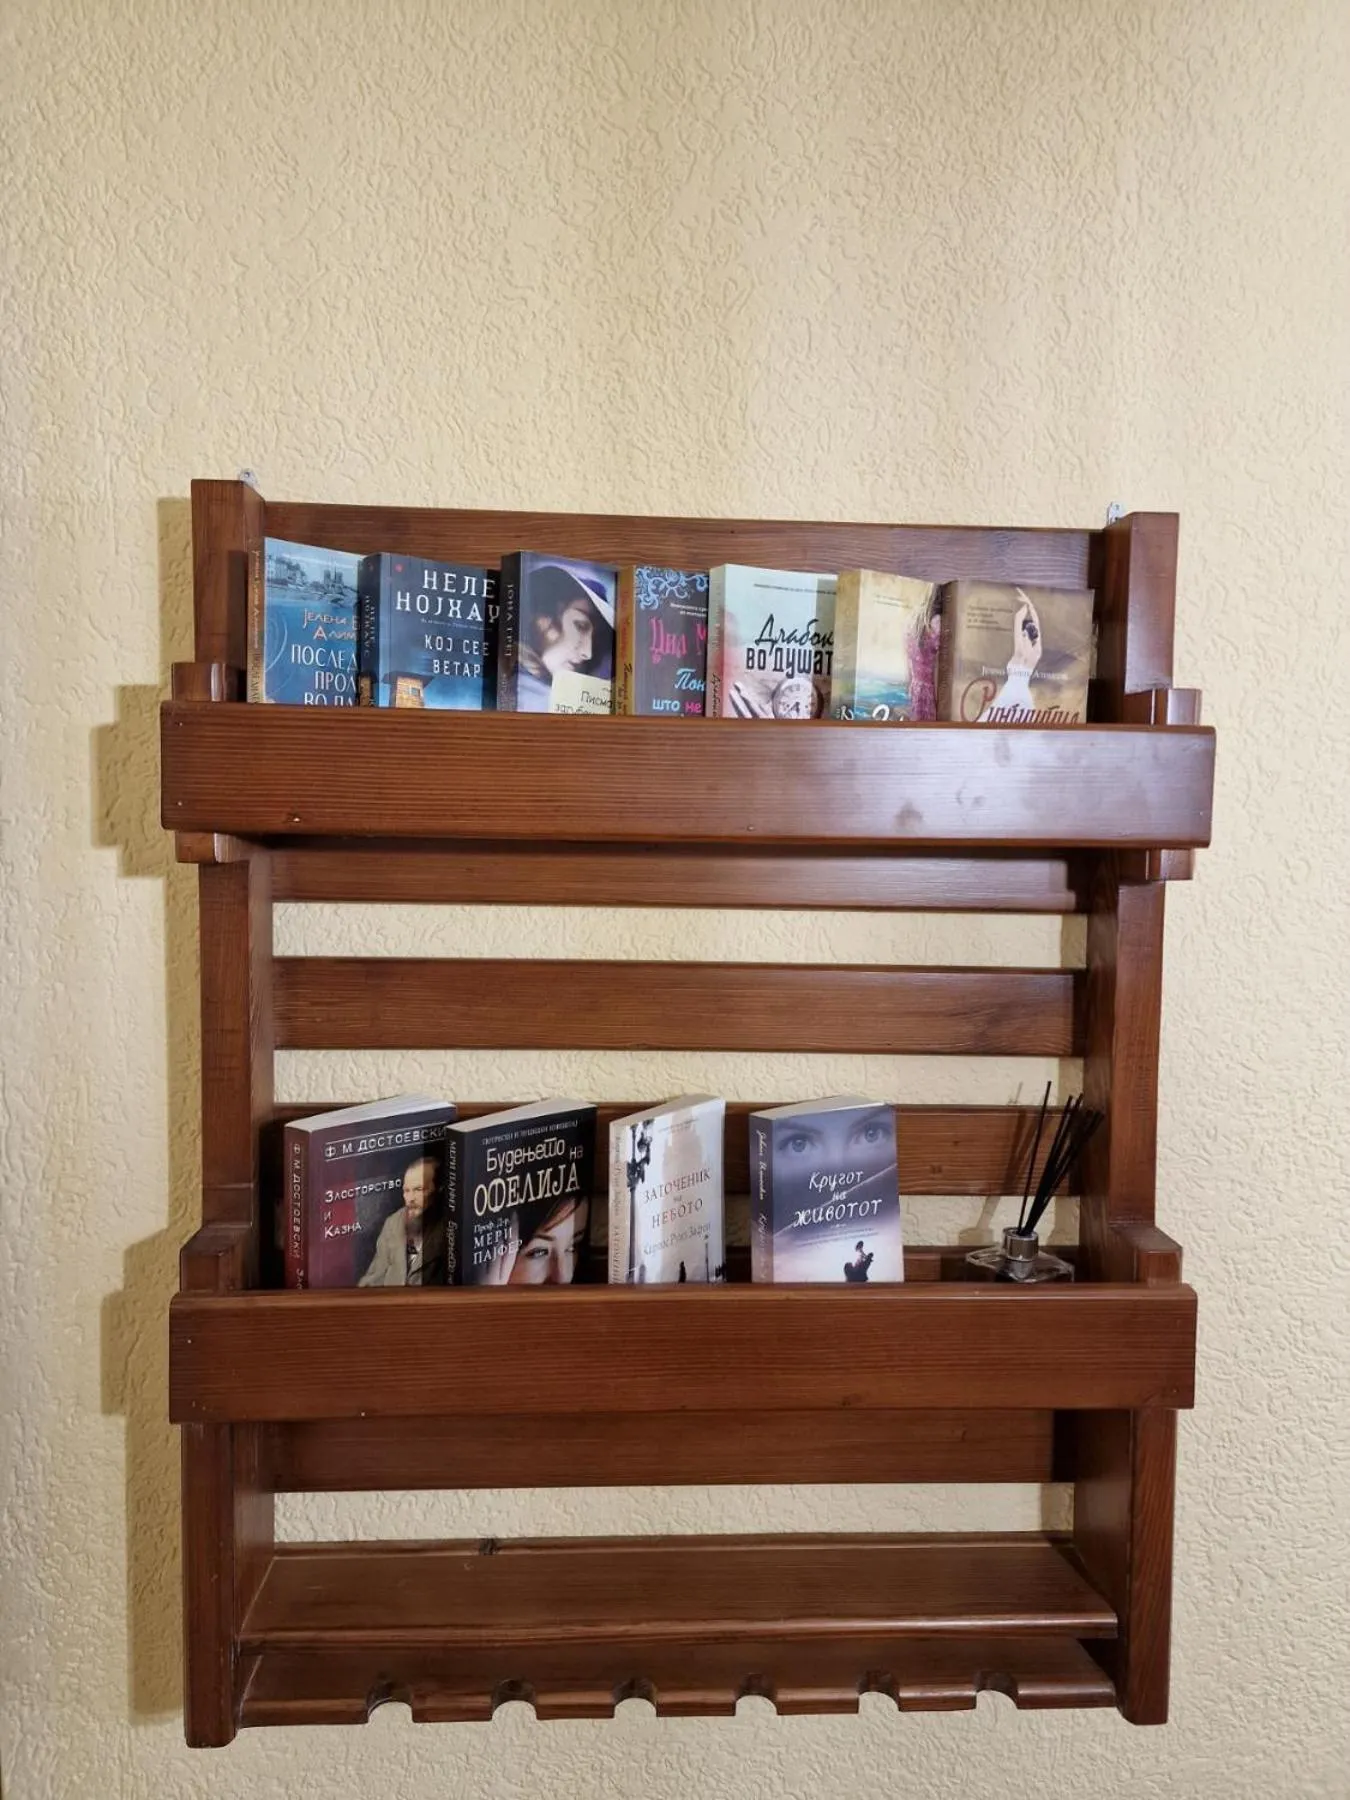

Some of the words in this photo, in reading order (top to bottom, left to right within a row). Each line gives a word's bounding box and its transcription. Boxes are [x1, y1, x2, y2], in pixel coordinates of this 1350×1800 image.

[422, 569, 496, 599] НЕЛЕ
[425, 634, 453, 652] КОЈ
[462, 639, 490, 656] СЕЕ
[432, 659, 481, 678] ВЕТАР
[342, 1142, 353, 1154] М
[473, 1162, 580, 1216] ОФЕЛИЈА
[808, 1170, 864, 1193] Кругот
[652, 1198, 703, 1229] НЕБОТО
[474, 1227, 512, 1249] МЕРИ
